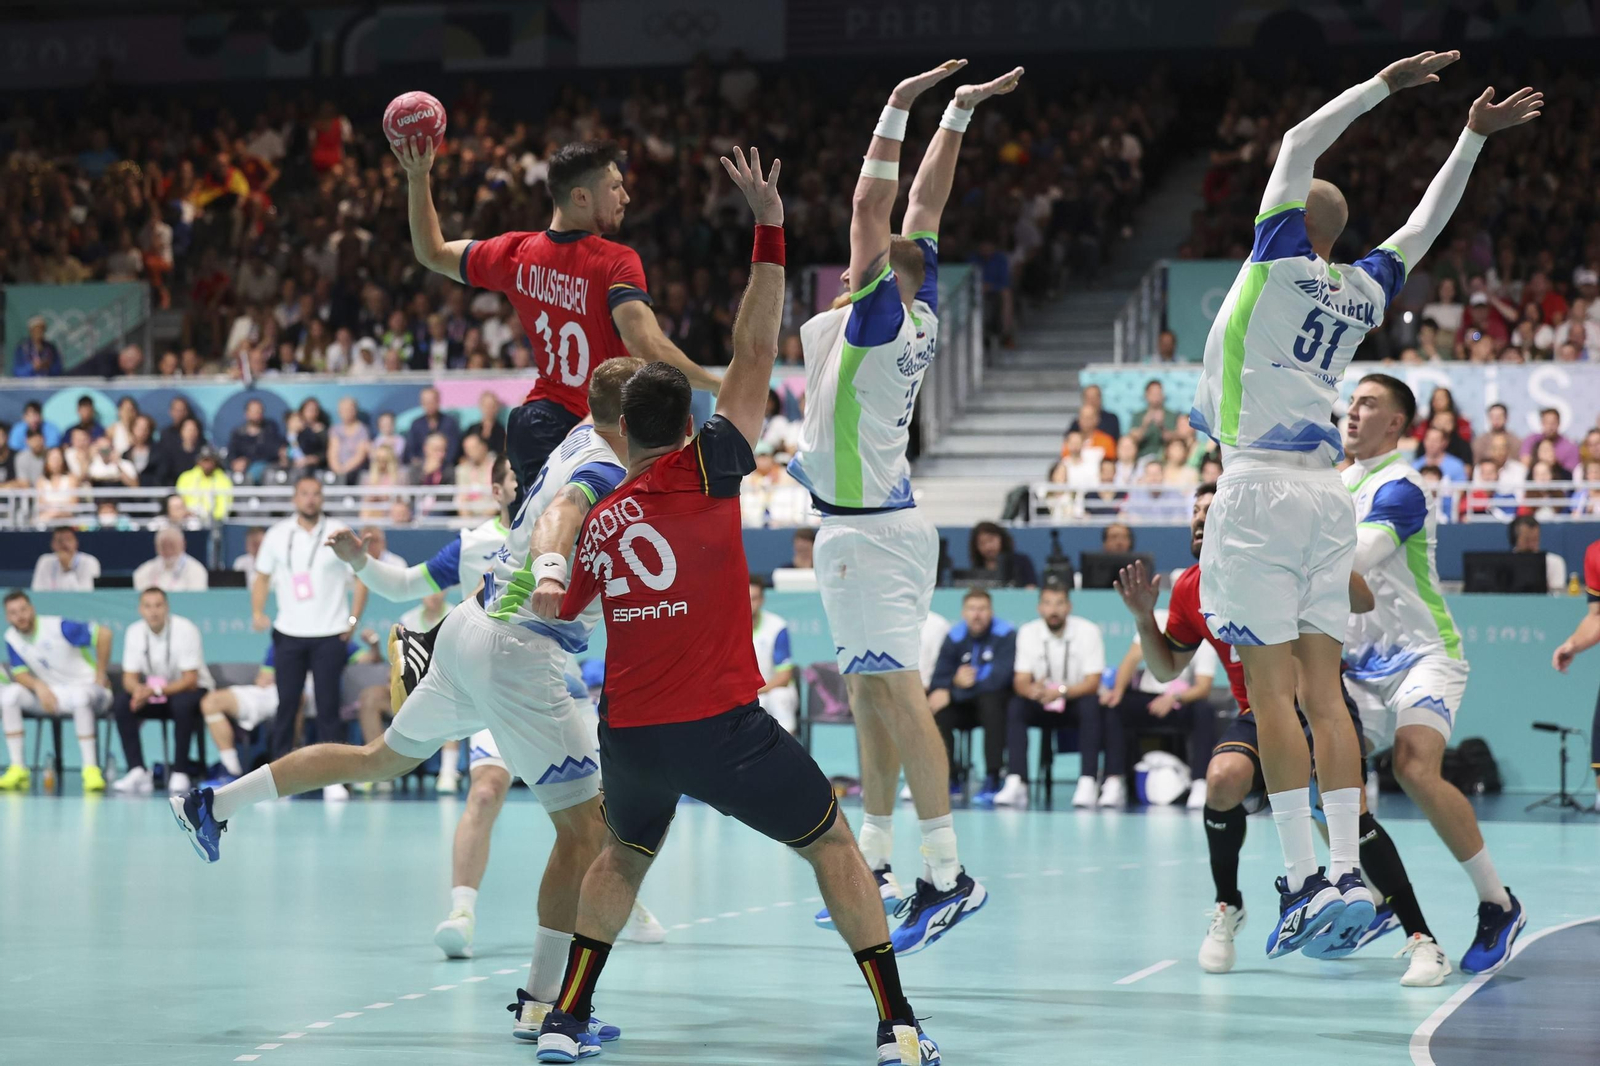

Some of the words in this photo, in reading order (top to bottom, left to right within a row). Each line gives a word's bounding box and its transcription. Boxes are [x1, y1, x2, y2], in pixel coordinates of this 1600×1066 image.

[845, 4, 995, 38] PARIS
[1015, 0, 1153, 33] 2024
[397, 107, 435, 127] molten
[534, 310, 590, 388] 10
[1293, 306, 1349, 371] 51
[592, 522, 677, 598] 20
[612, 600, 688, 622] ESPAÑA
